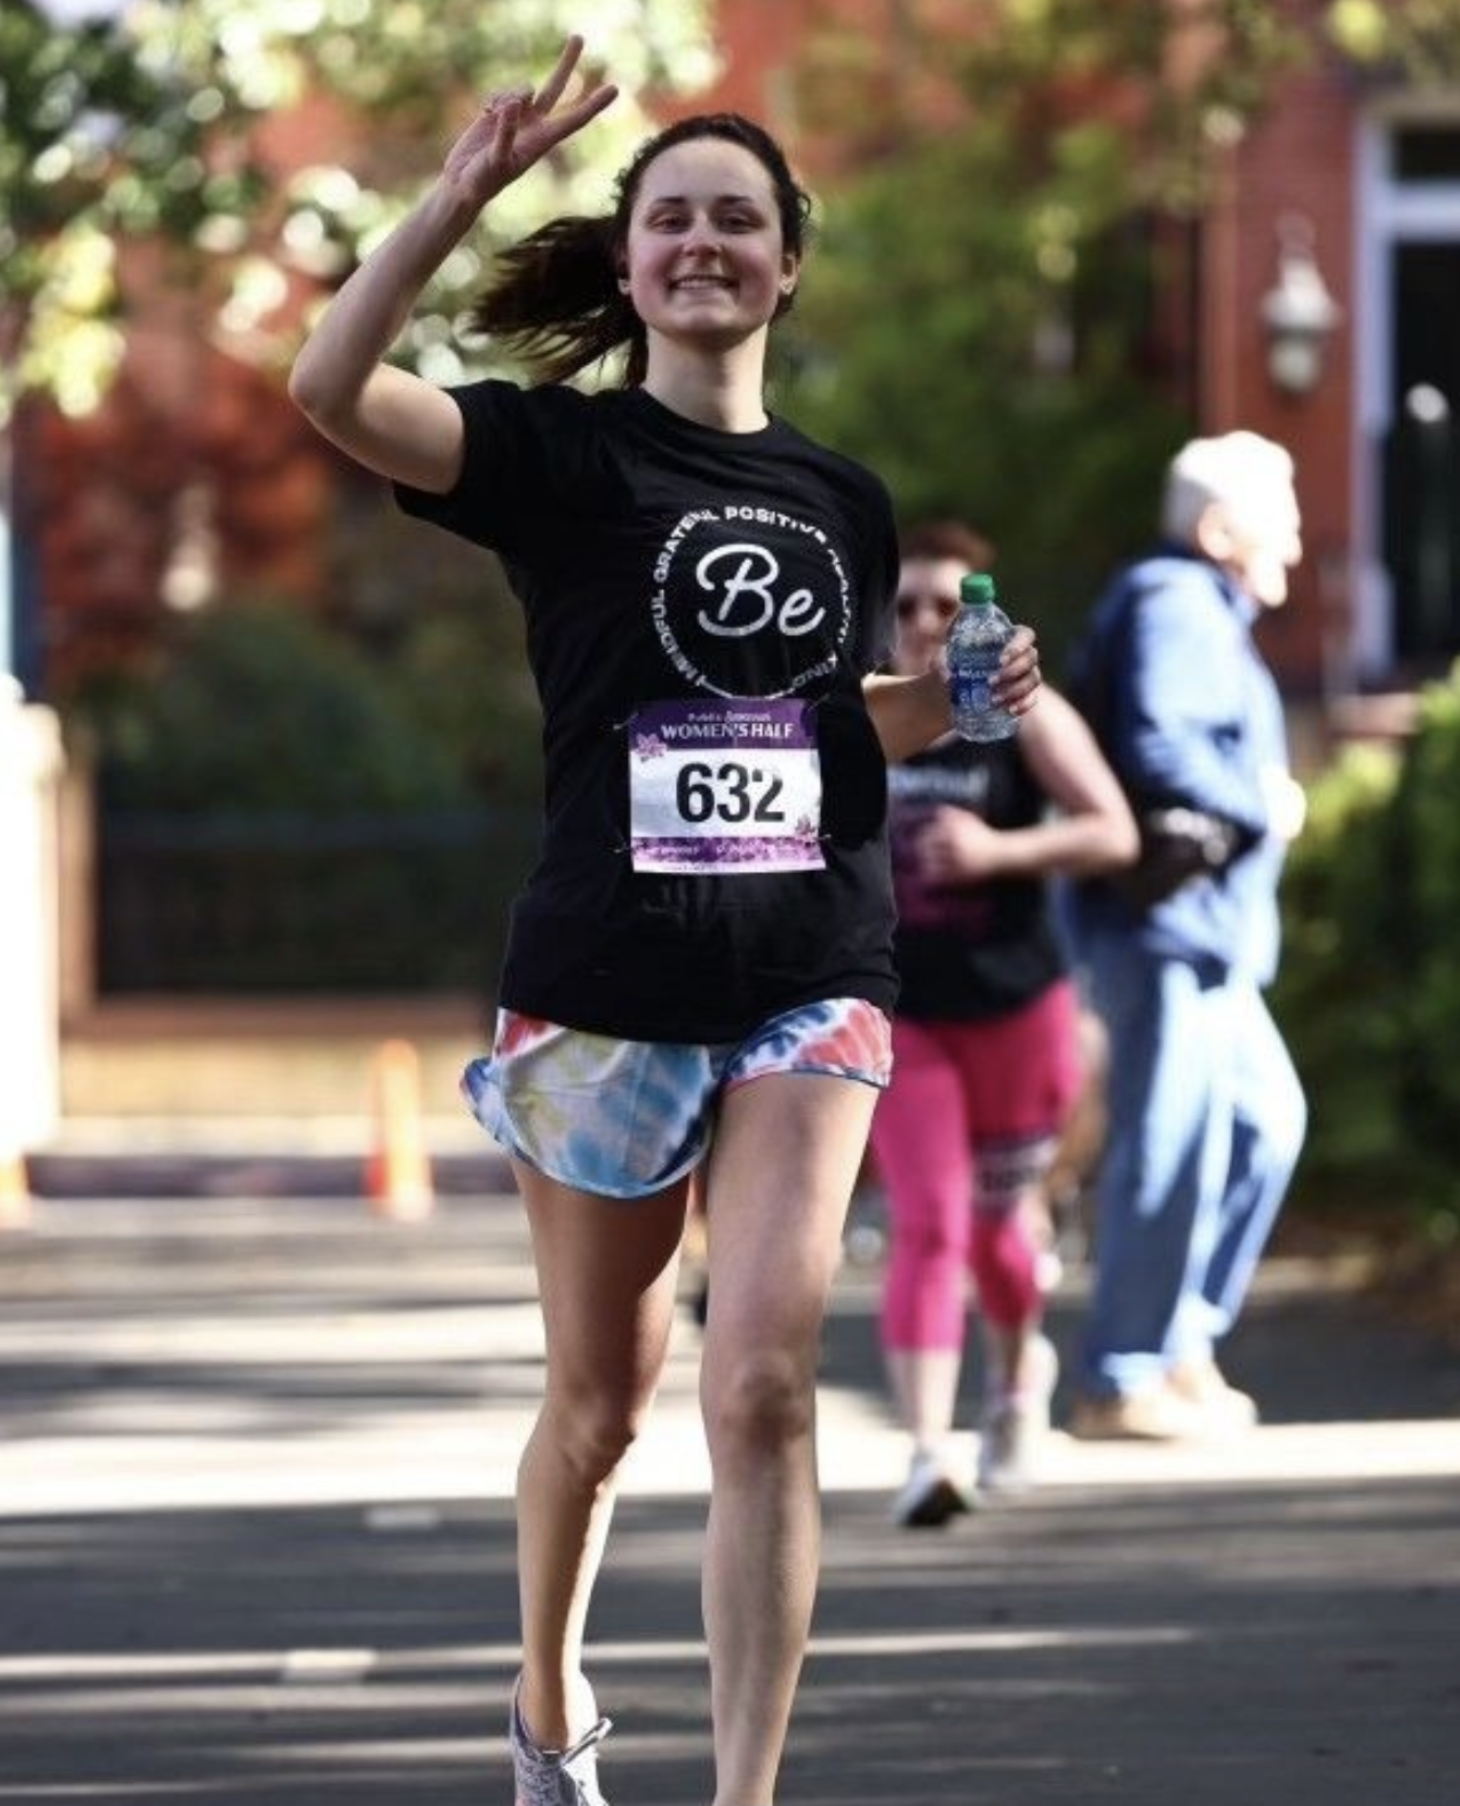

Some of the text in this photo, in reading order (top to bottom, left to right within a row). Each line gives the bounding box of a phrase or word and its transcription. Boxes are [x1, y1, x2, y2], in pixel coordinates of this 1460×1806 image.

[696, 543, 826, 636] Be
[661, 723, 794, 739] WOMEN'S HALF
[676, 762, 785, 823] 632
